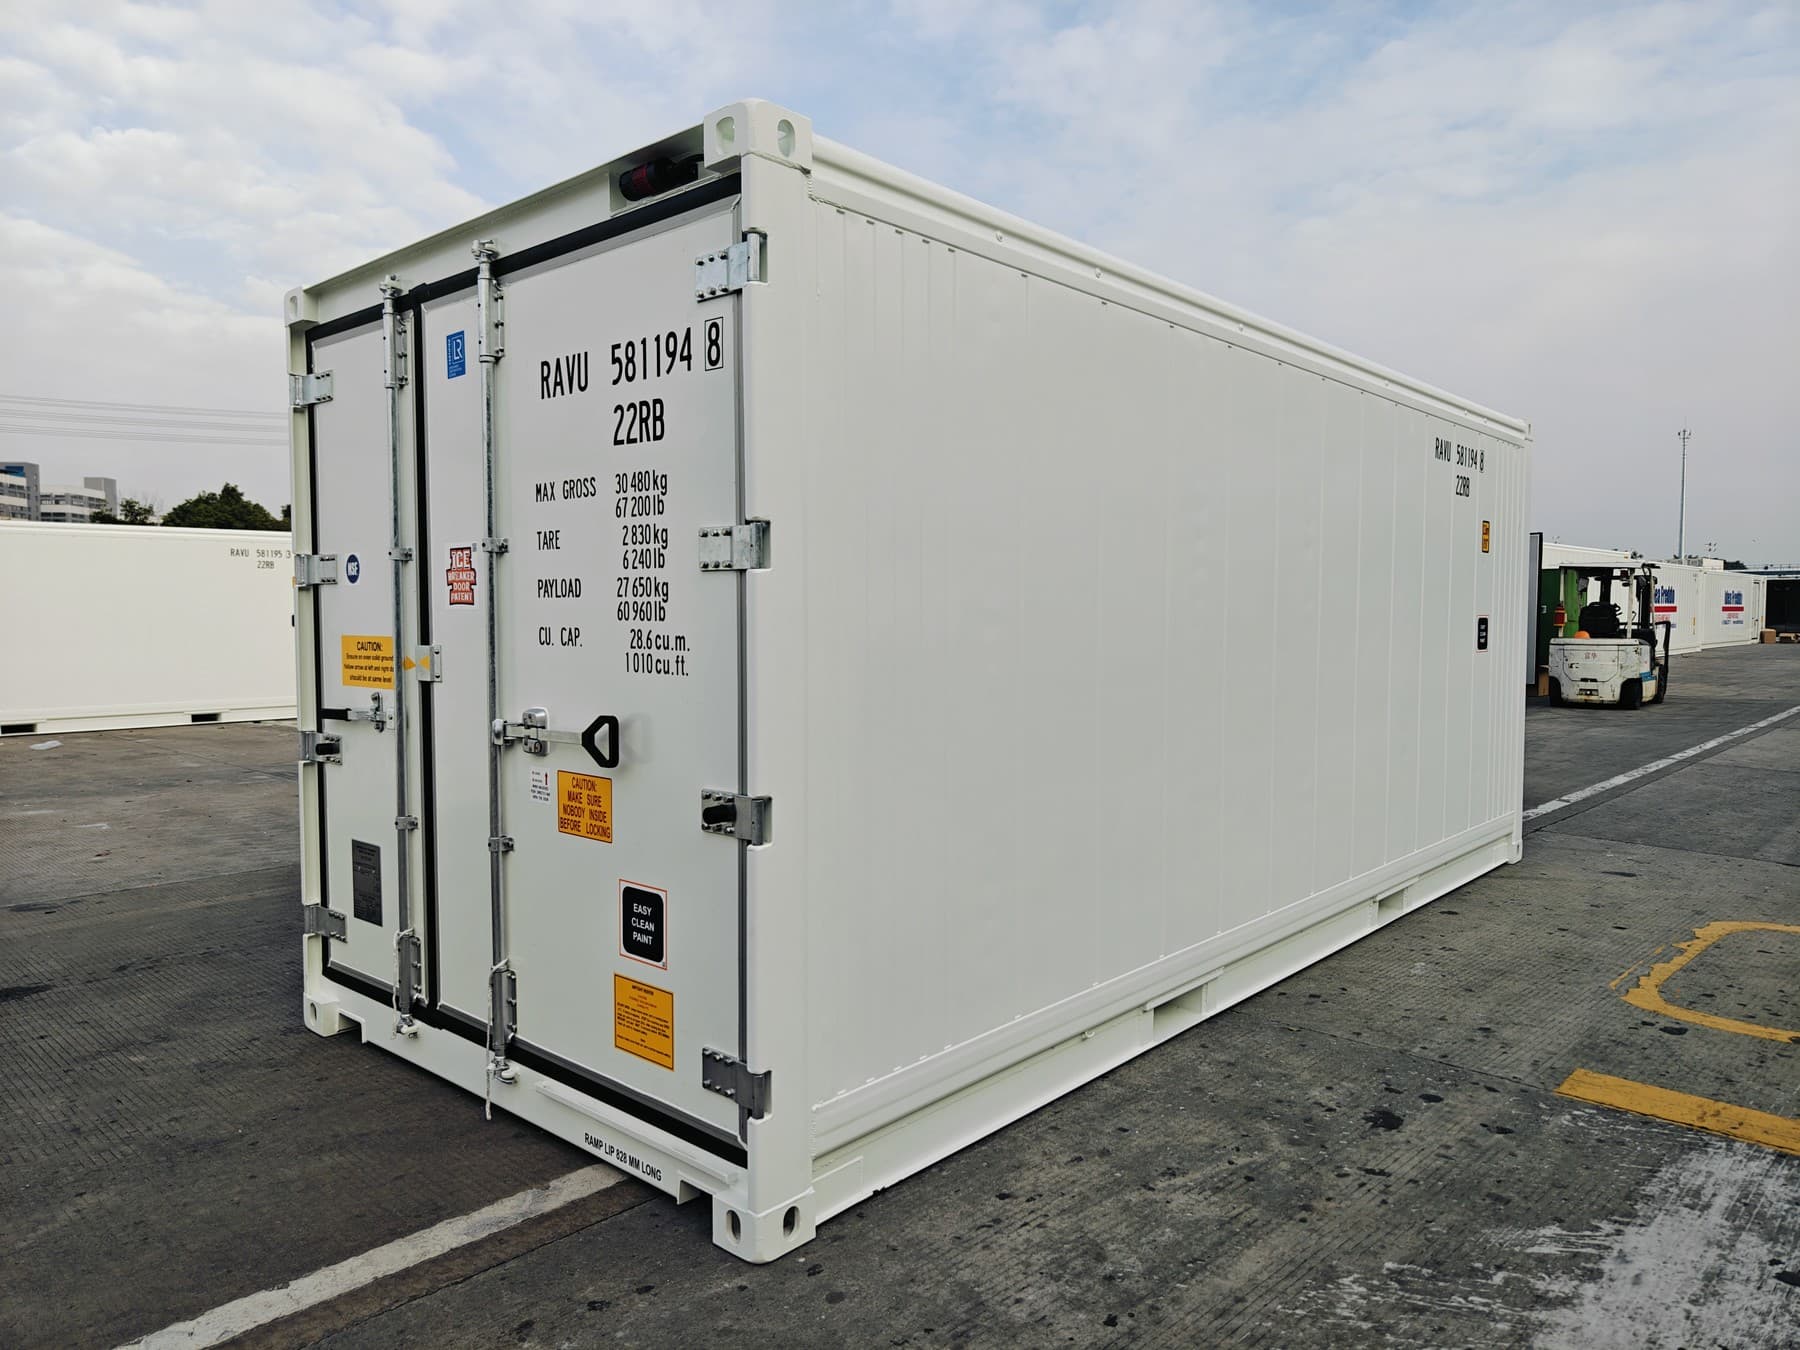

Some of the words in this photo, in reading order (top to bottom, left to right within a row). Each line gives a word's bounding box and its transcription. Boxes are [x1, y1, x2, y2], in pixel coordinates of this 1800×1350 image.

[541, 352, 588, 400] RAVU
[611, 327, 693, 386] 581194
[708, 322, 720, 367] 8
[613, 398, 665, 446] 22RB
[1435, 437, 1451, 462] RAVU
[1456, 444, 1478, 470] 581194
[535, 481, 555, 502] MAX
[562, 477, 597, 500] GROSS
[536, 529, 561, 550] TARE
[230, 548, 249, 557] RAVU
[451, 549, 471, 570] ICE
[452, 582, 471, 591] DOOR
[537, 578, 582, 599] PAYLOAD
[538, 626, 555, 647] CU.
[560, 627, 583, 647] CAP.
[572, 777, 597, 792] CAUTION:
[567, 790, 583, 804] MAKE
[586, 793, 602, 807] SURE
[562, 804, 586, 818] NOBODY
[589, 809, 607, 823] INSIDE
[560, 817, 582, 832] BEFORE
[585, 823, 611, 838] LOCKING
[633, 903, 652, 917] EASY
[631, 917, 655, 932] CLEAN
[632, 931, 653, 945] PAINT
[585, 1133, 603, 1150] RAMP
[604, 1143, 615, 1156] LIP
[629, 1155, 640, 1170] MM
[641, 1161, 662, 1181] LONG
